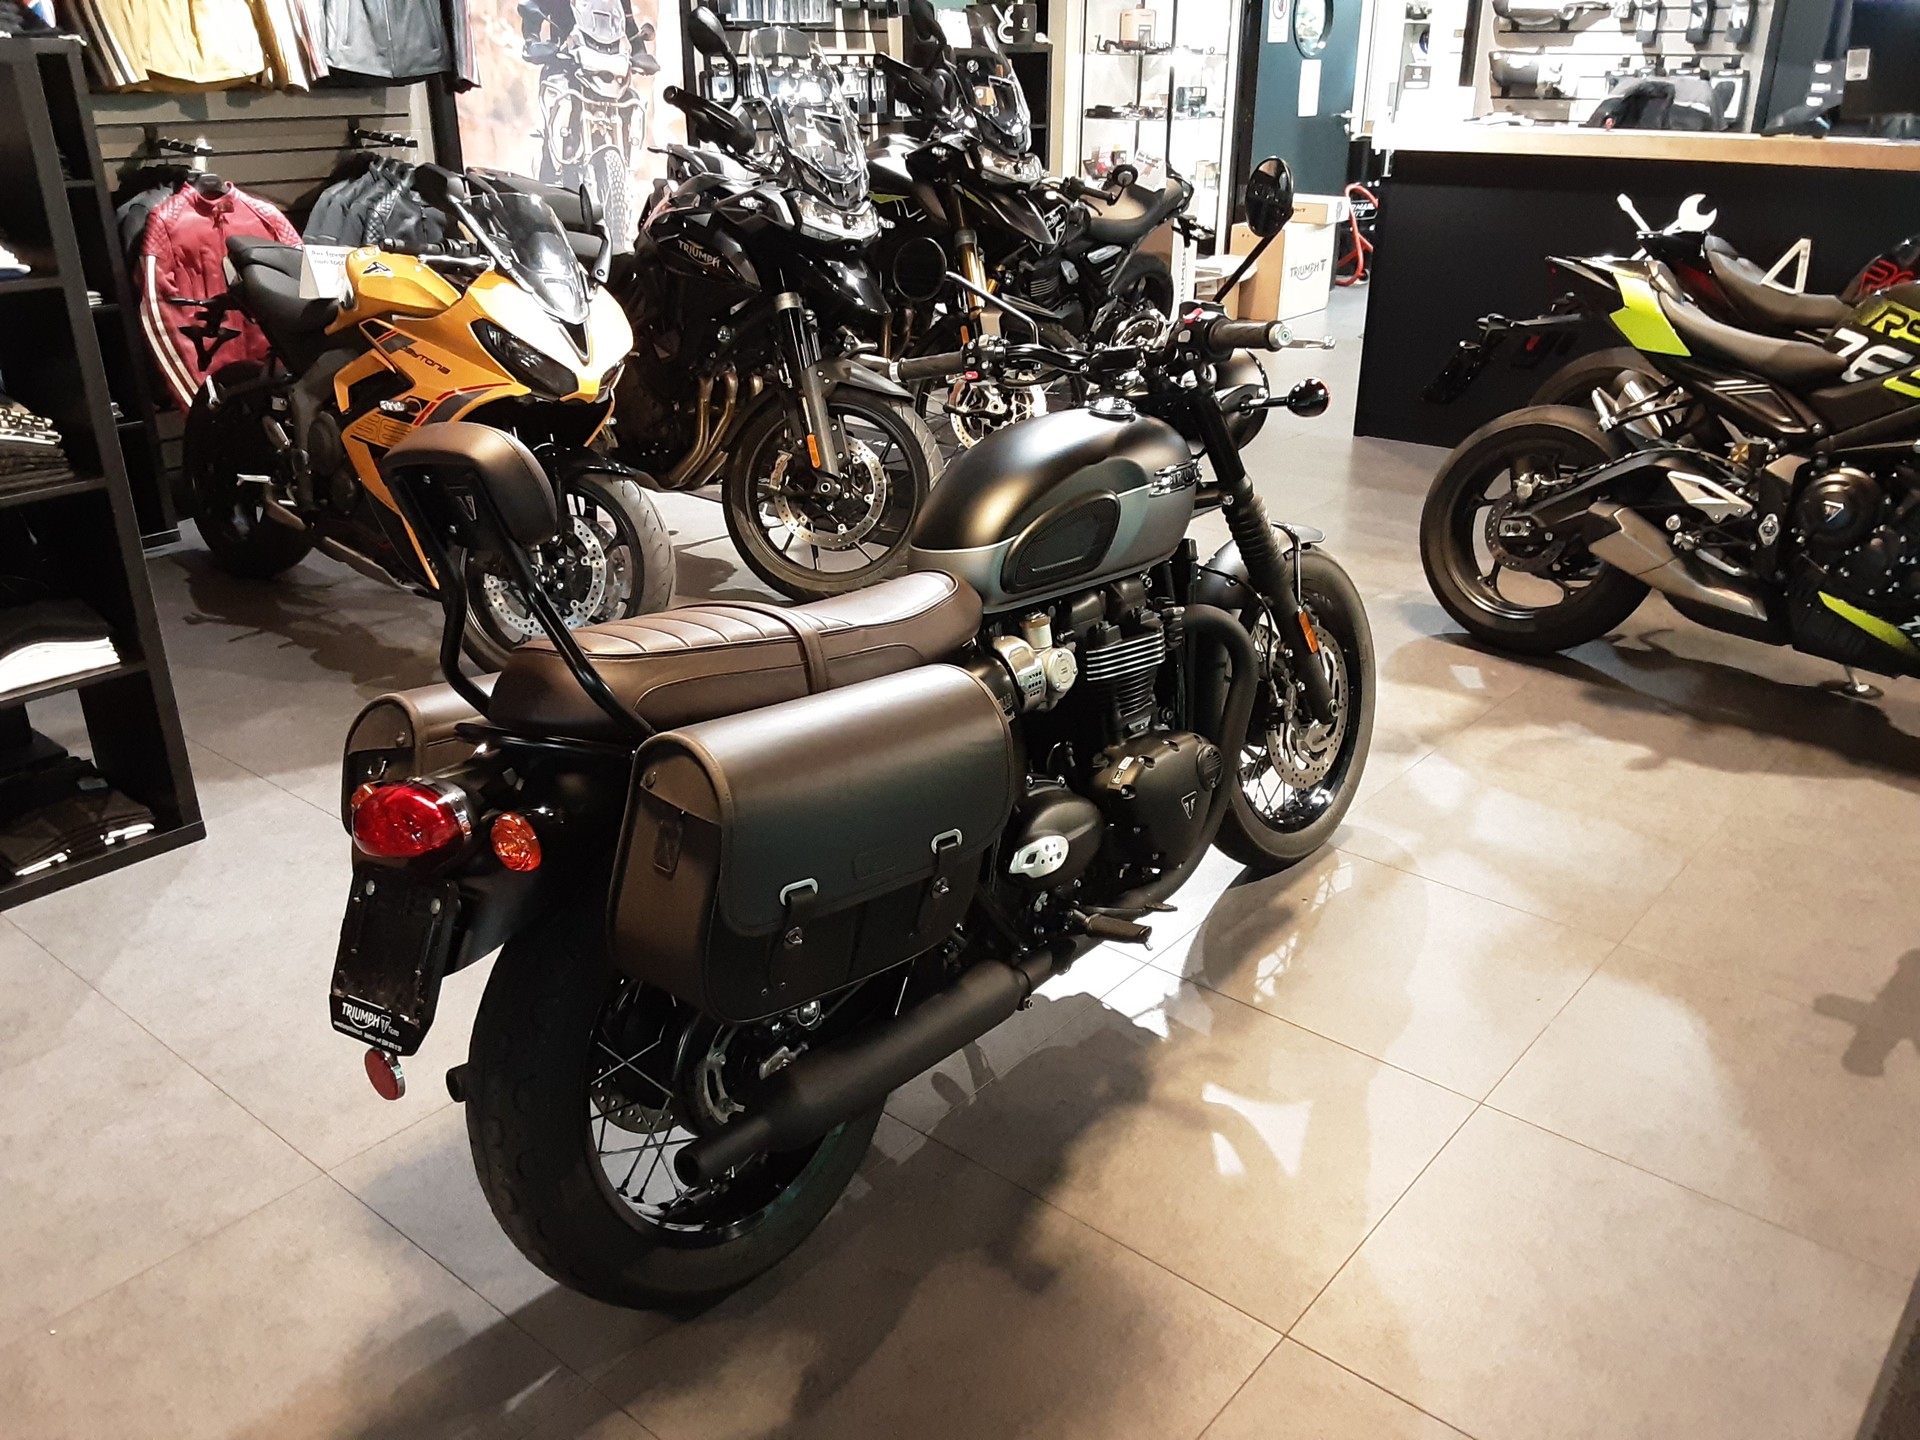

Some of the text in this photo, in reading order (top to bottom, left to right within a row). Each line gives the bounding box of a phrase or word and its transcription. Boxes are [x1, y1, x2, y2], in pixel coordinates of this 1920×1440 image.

[678, 239, 720, 268] TRIUMPH
[1290, 262, 1320, 280] TRIUMPH
[342, 1002, 380, 1029] TRIUMPH
